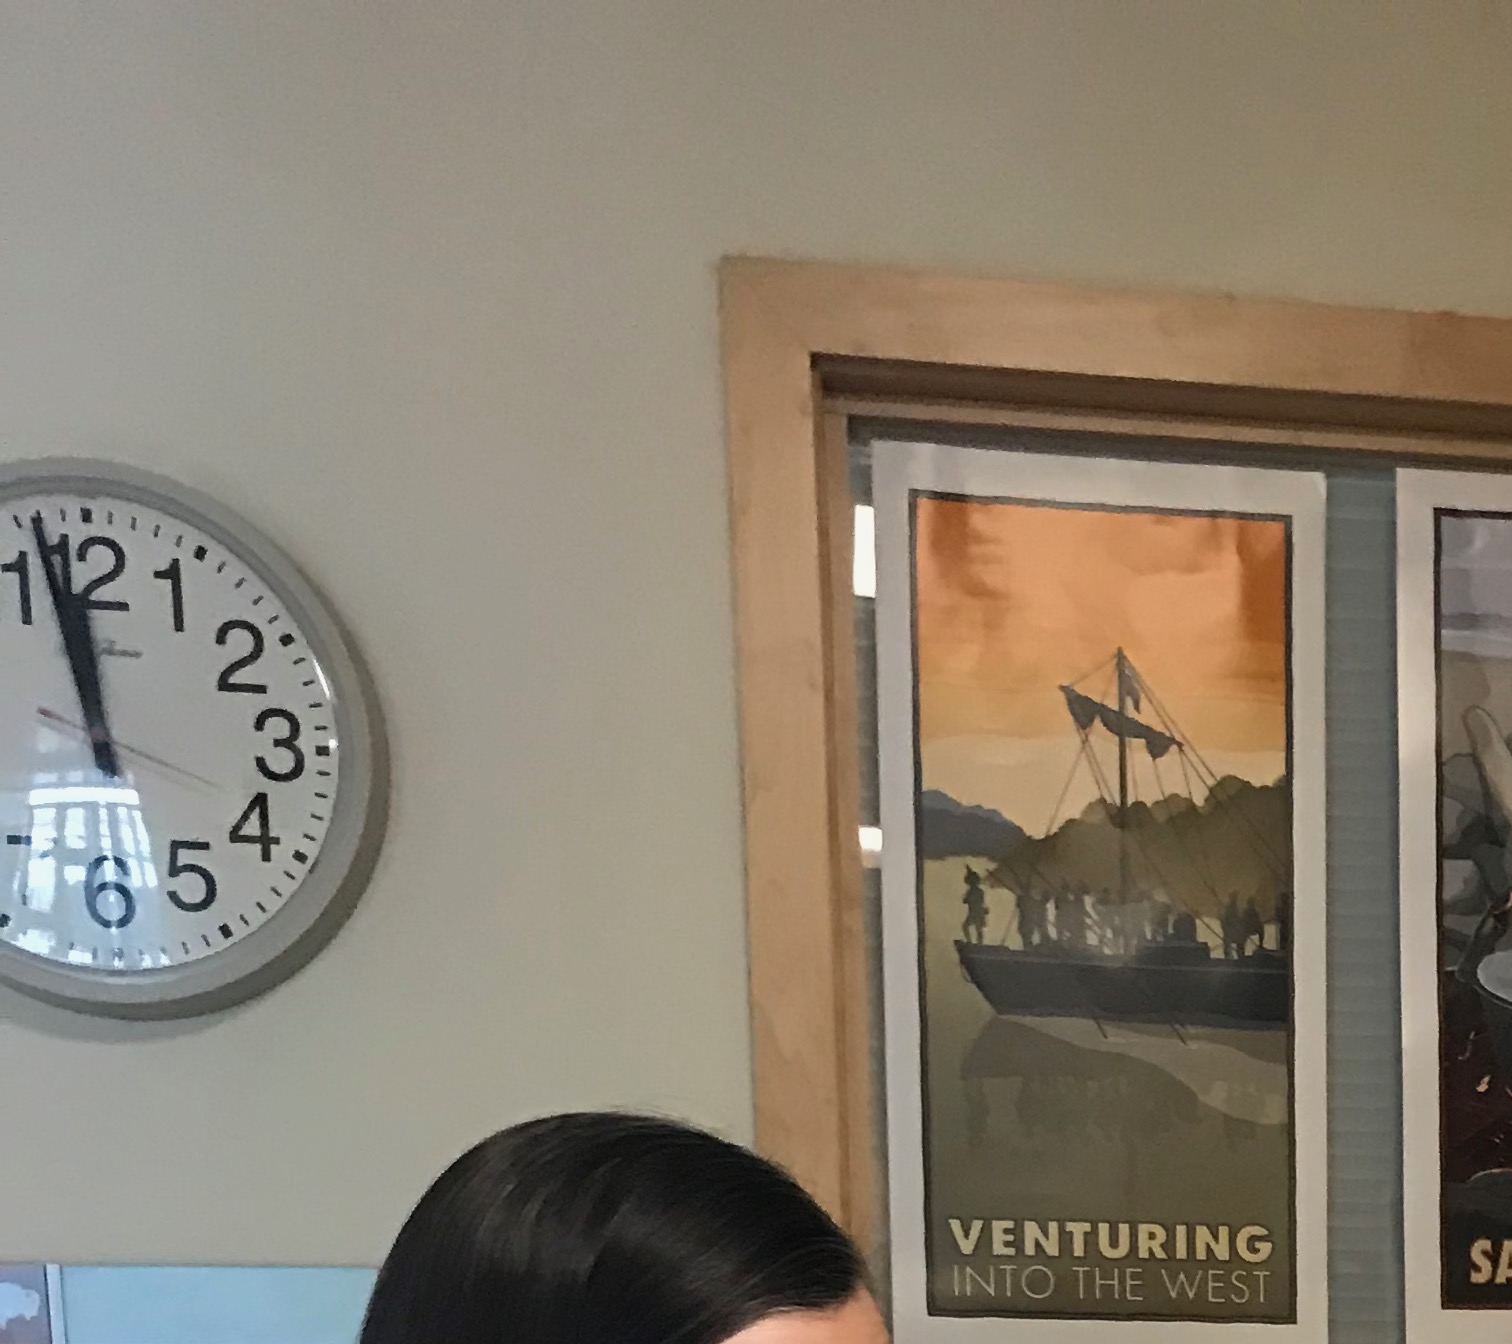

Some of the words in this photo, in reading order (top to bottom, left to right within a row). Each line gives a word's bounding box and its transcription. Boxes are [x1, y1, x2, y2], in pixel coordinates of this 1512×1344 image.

[153, 557, 186, 632] 1
[215, 619, 268, 694] 2
[254, 707, 306, 783] 3
[228, 792, 280, 862] 4
[84, 854, 136, 930] 6
[166, 840, 218, 913] 5
[948, 1219, 1273, 1263] VENTURING
[953, 1265, 1055, 1299] INTO
[1072, 1267, 1143, 1300] THE
[1161, 1269, 1271, 1304] WEST
